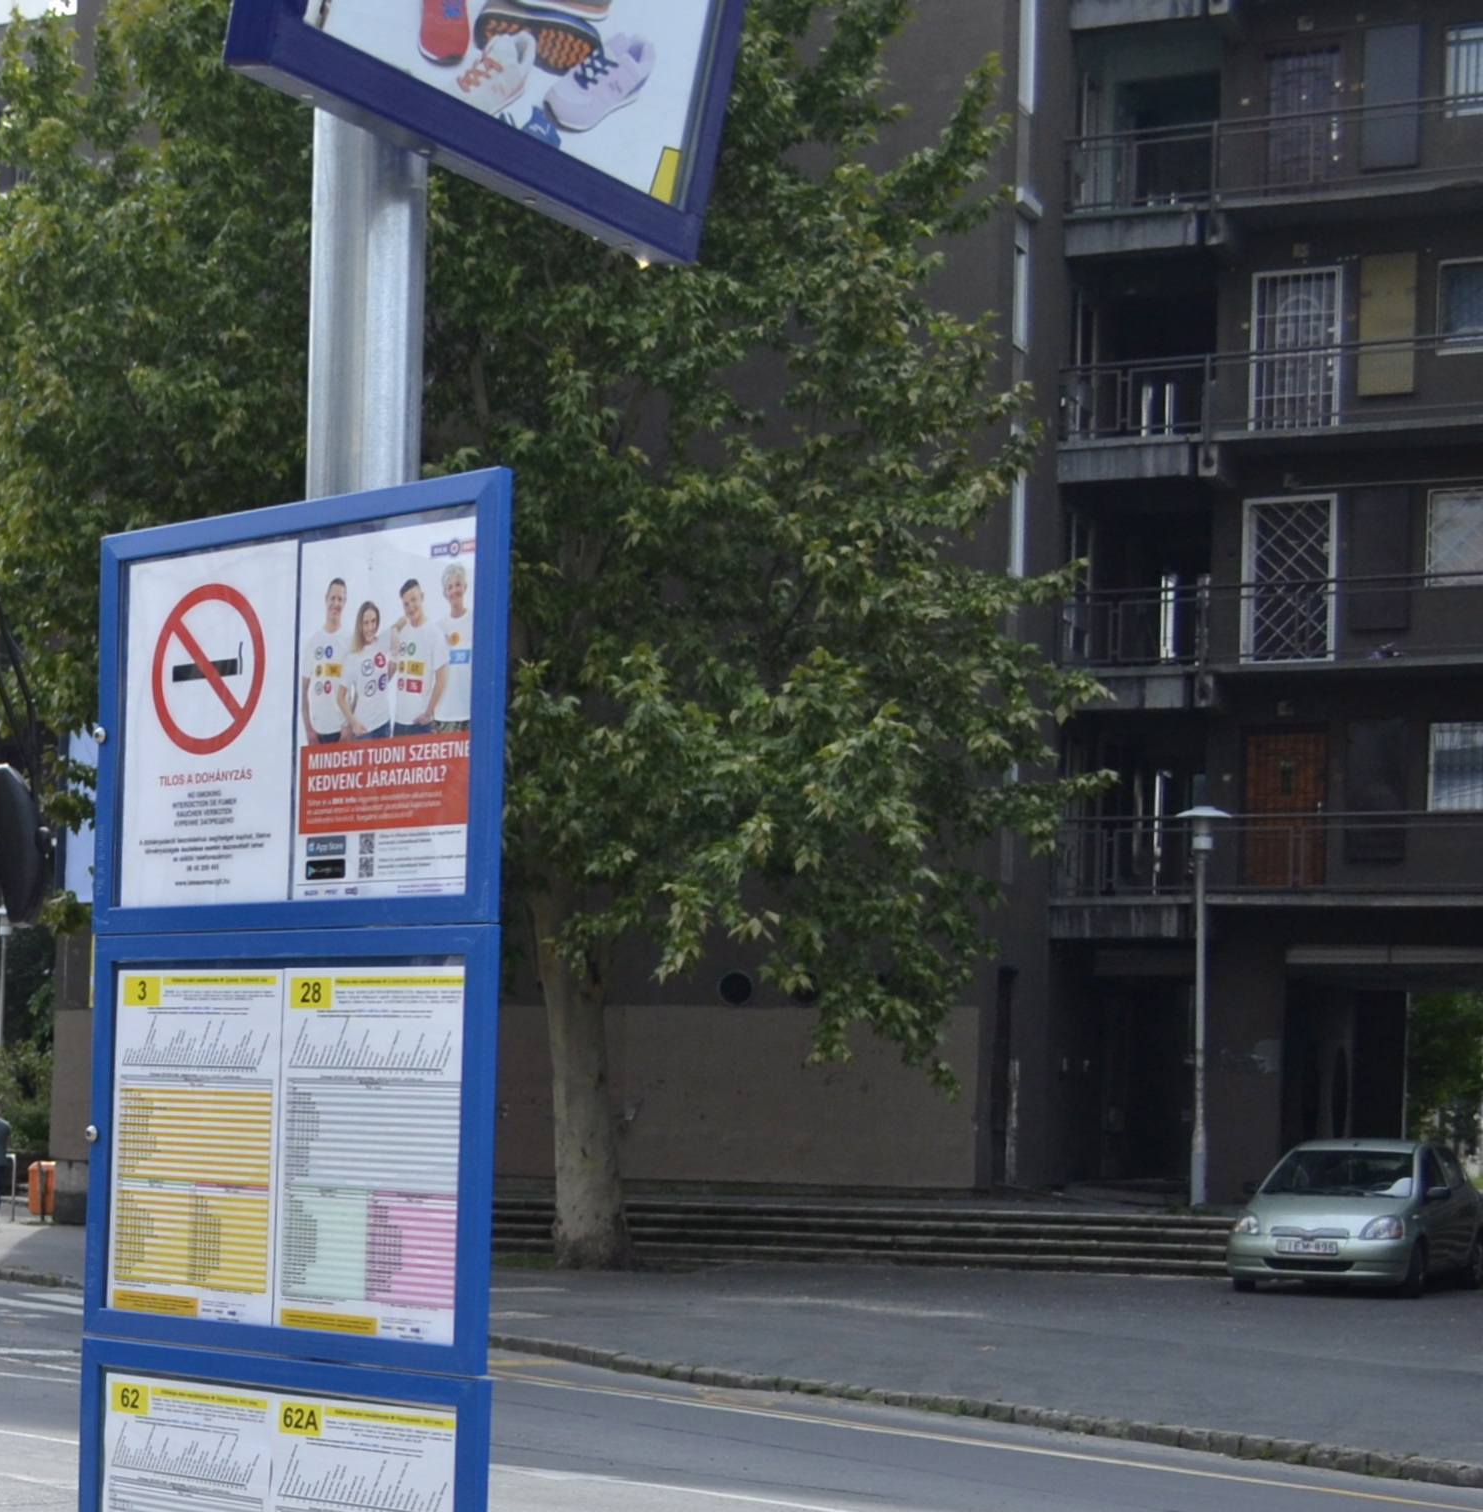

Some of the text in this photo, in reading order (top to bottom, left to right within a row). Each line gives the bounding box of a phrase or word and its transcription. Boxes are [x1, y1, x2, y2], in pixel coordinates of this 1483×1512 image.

[308, 740, 470, 771] MINDENT TUDNI SZERETNE
[159, 768, 253, 787] TILOS A DOHÁNYZÁS
[307, 763, 448, 792] KEDVENC JÁRATAIRÓL?
[137, 980, 147, 1001] 3
[300, 981, 323, 1004] 28
[120, 1387, 140, 1409] 62
[283, 1407, 319, 1432] 62A
